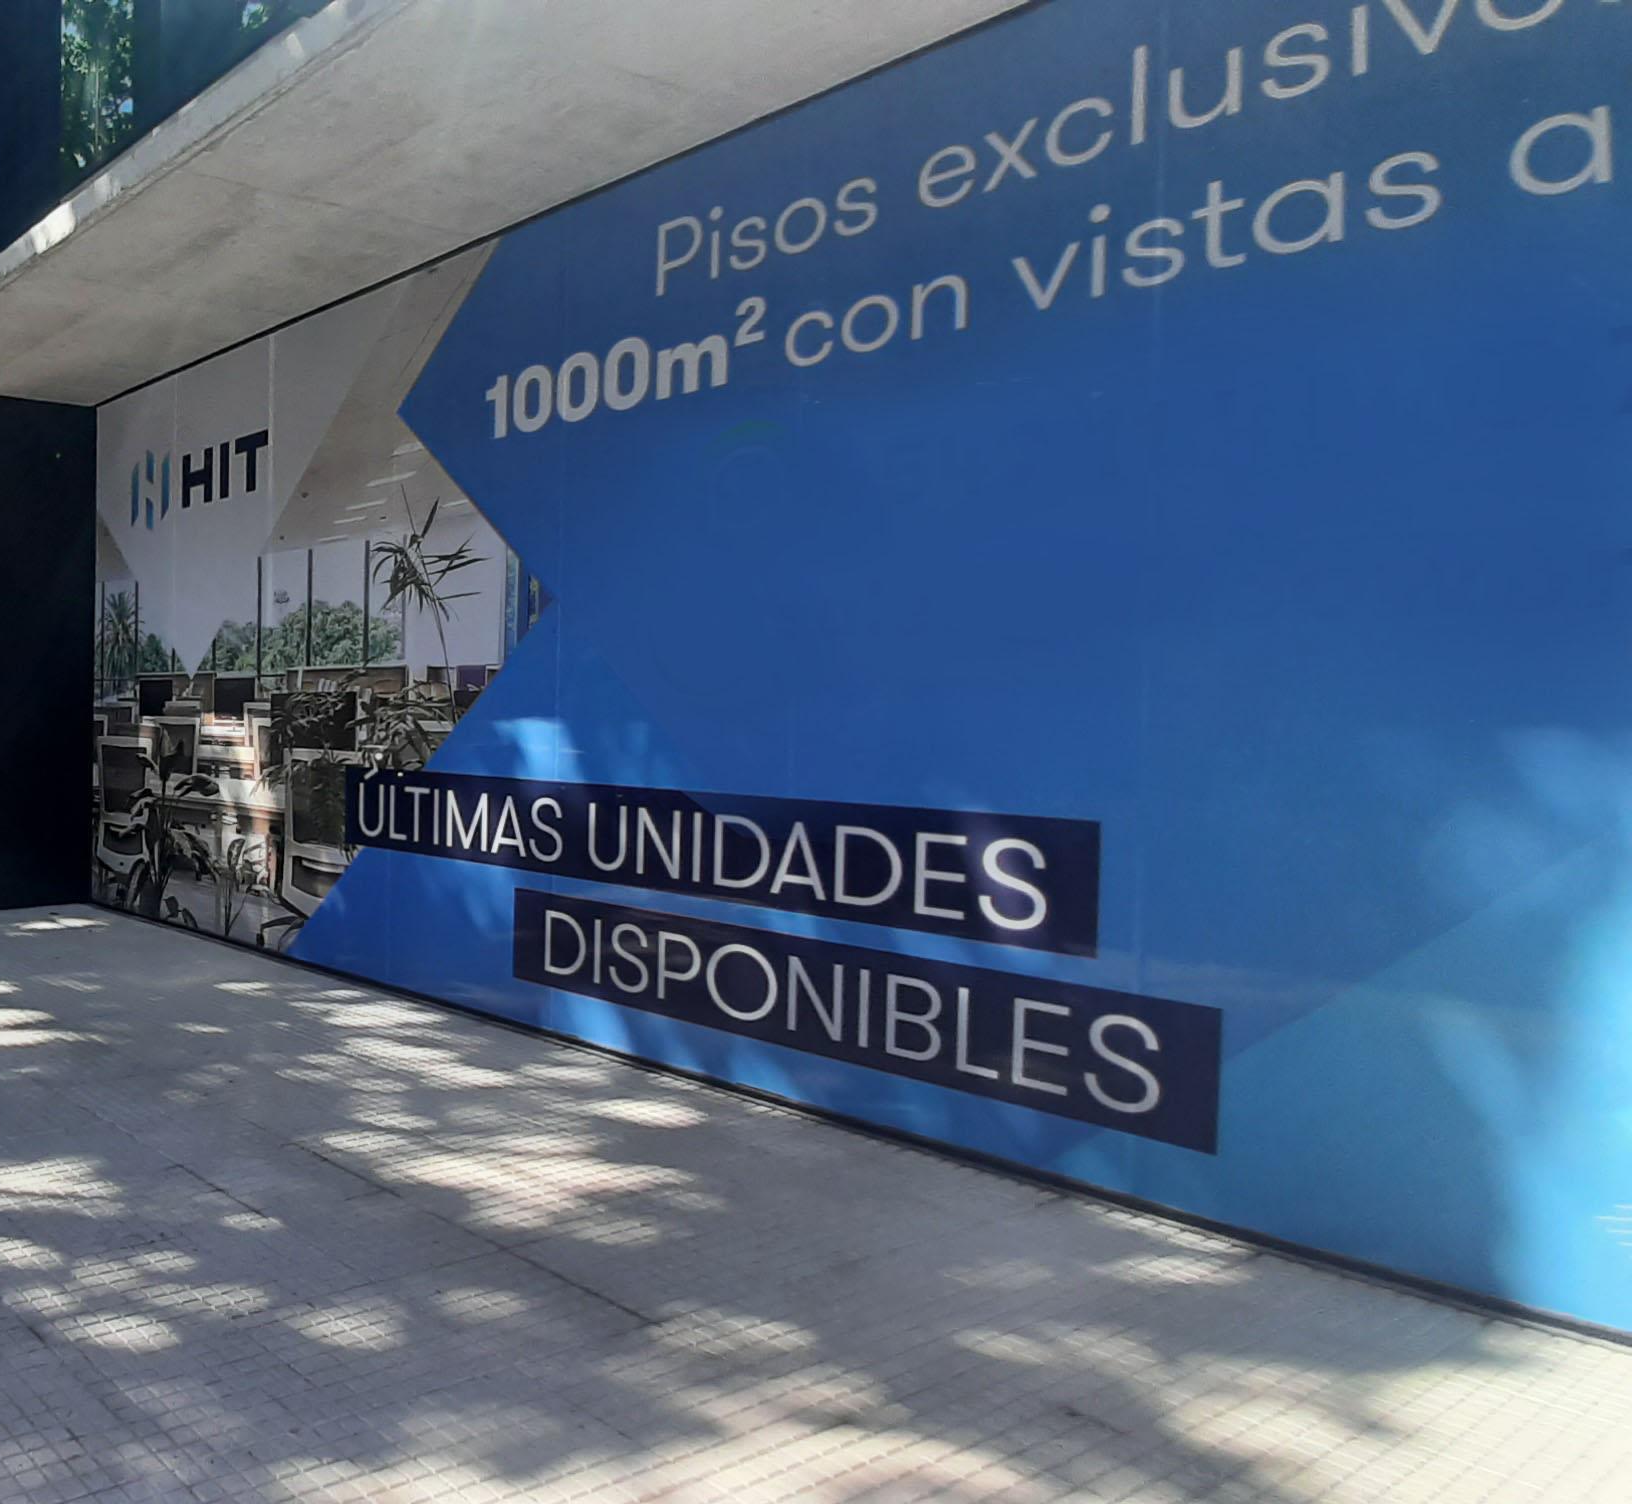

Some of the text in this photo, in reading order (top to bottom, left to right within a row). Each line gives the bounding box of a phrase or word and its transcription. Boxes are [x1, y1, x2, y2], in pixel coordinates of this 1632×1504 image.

[655, 0, 1621, 297] Pisos exclusiv
[784, 273, 968, 367] con
[1011, 150, 1443, 311] vistas
[1509, 105, 1614, 196] a
[181, 429, 269, 509] HIT
[358, 766, 1048, 932] ÚLTIMAS UNIDADES
[543, 908, 1161, 1115] DISPONIBLES
